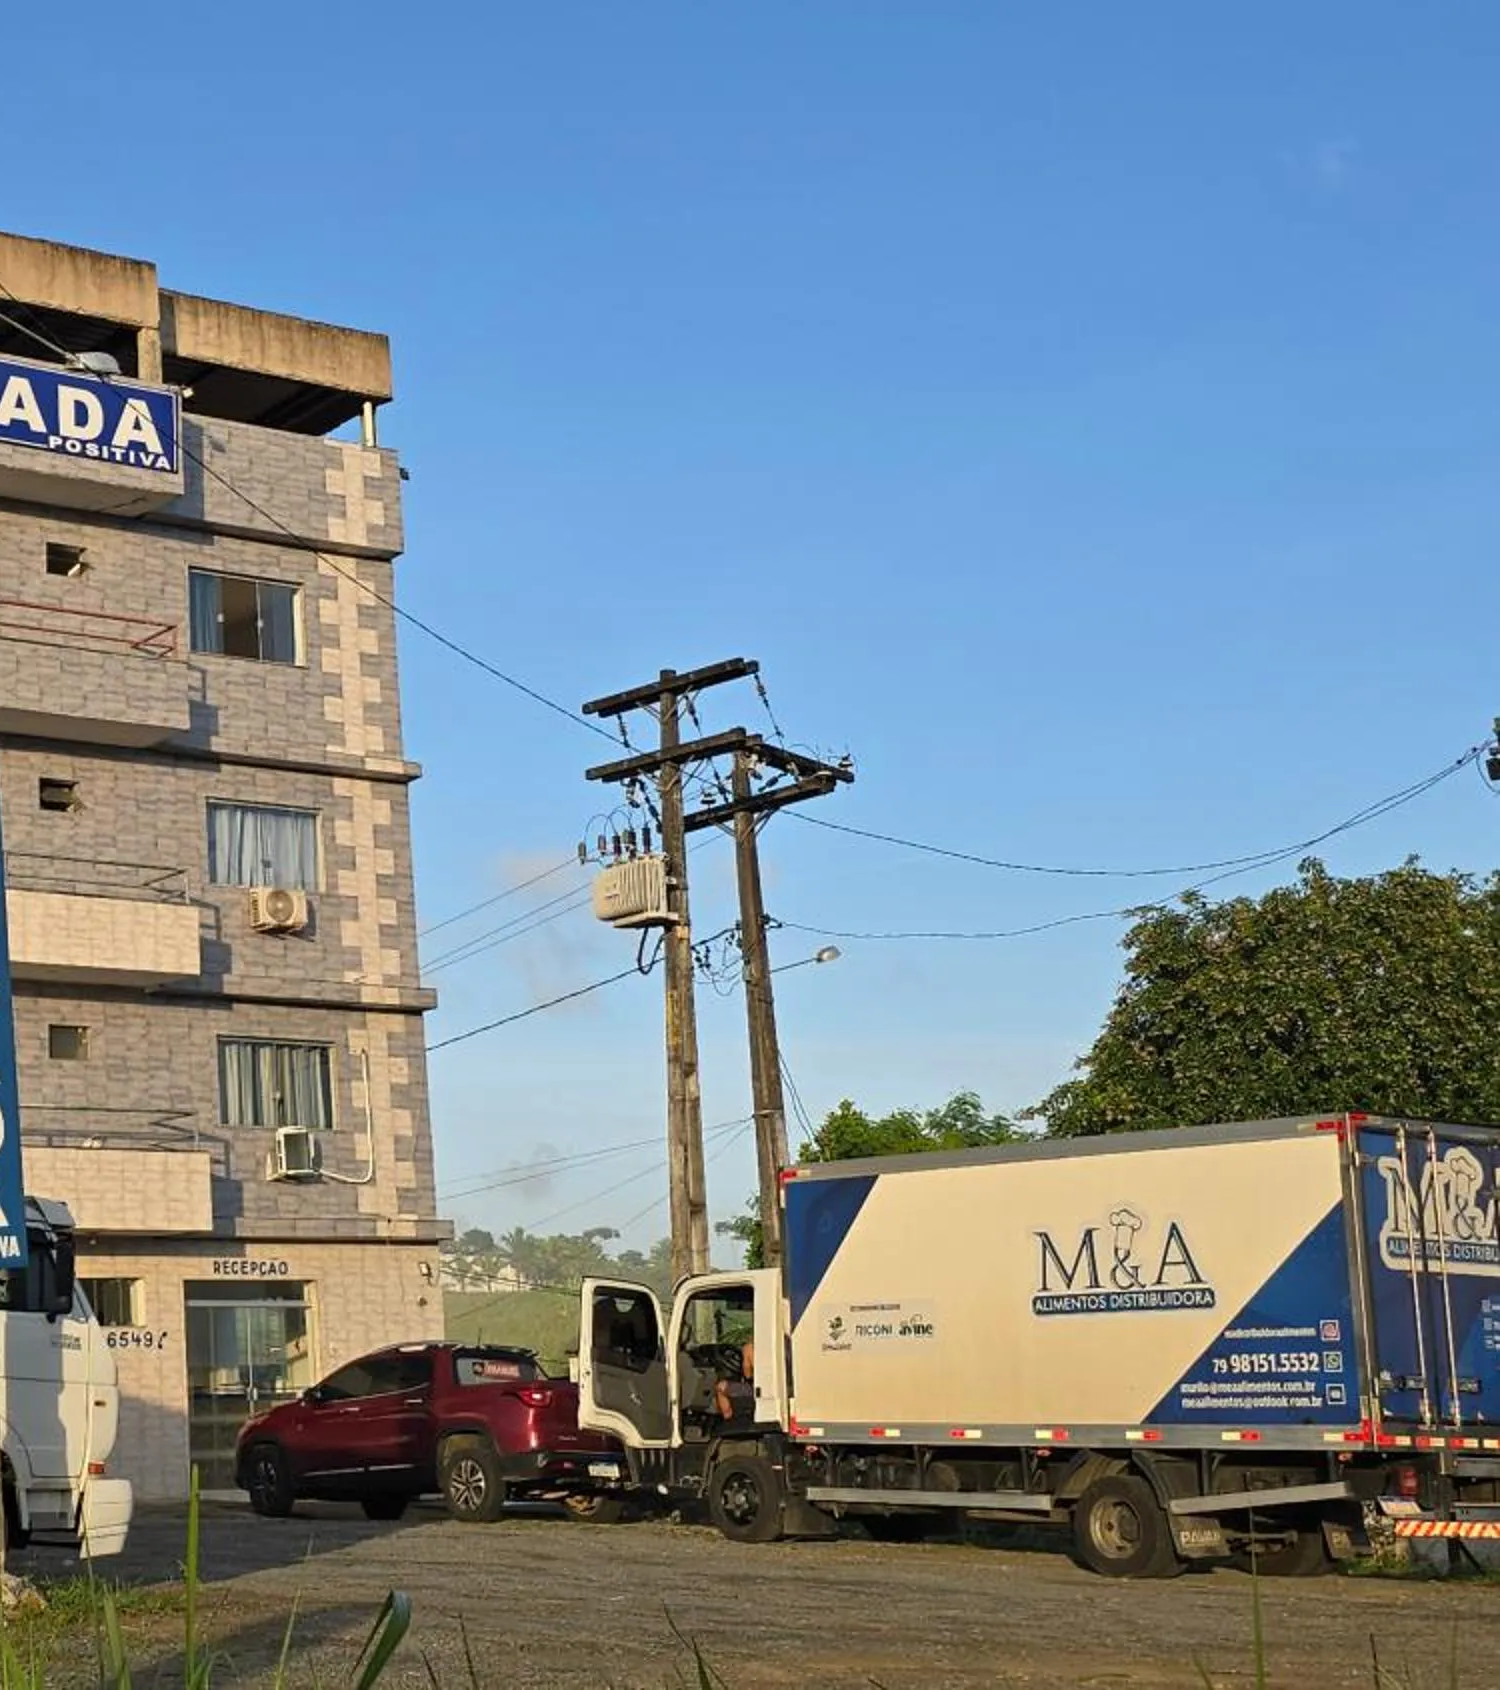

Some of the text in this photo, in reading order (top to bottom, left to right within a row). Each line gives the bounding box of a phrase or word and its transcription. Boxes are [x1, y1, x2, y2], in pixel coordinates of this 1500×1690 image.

[48, 434, 172, 471] POSITIVA
[1382, 1162, 1500, 1241] M&
[1032, 1221, 1209, 1291] M&A
[1034, 1290, 1214, 1313] ALIMENTOS DISTRIBUIDORA
[107, 1331, 154, 1348] 6549
[1213, 1351, 1320, 1374] 79 98151.5532
